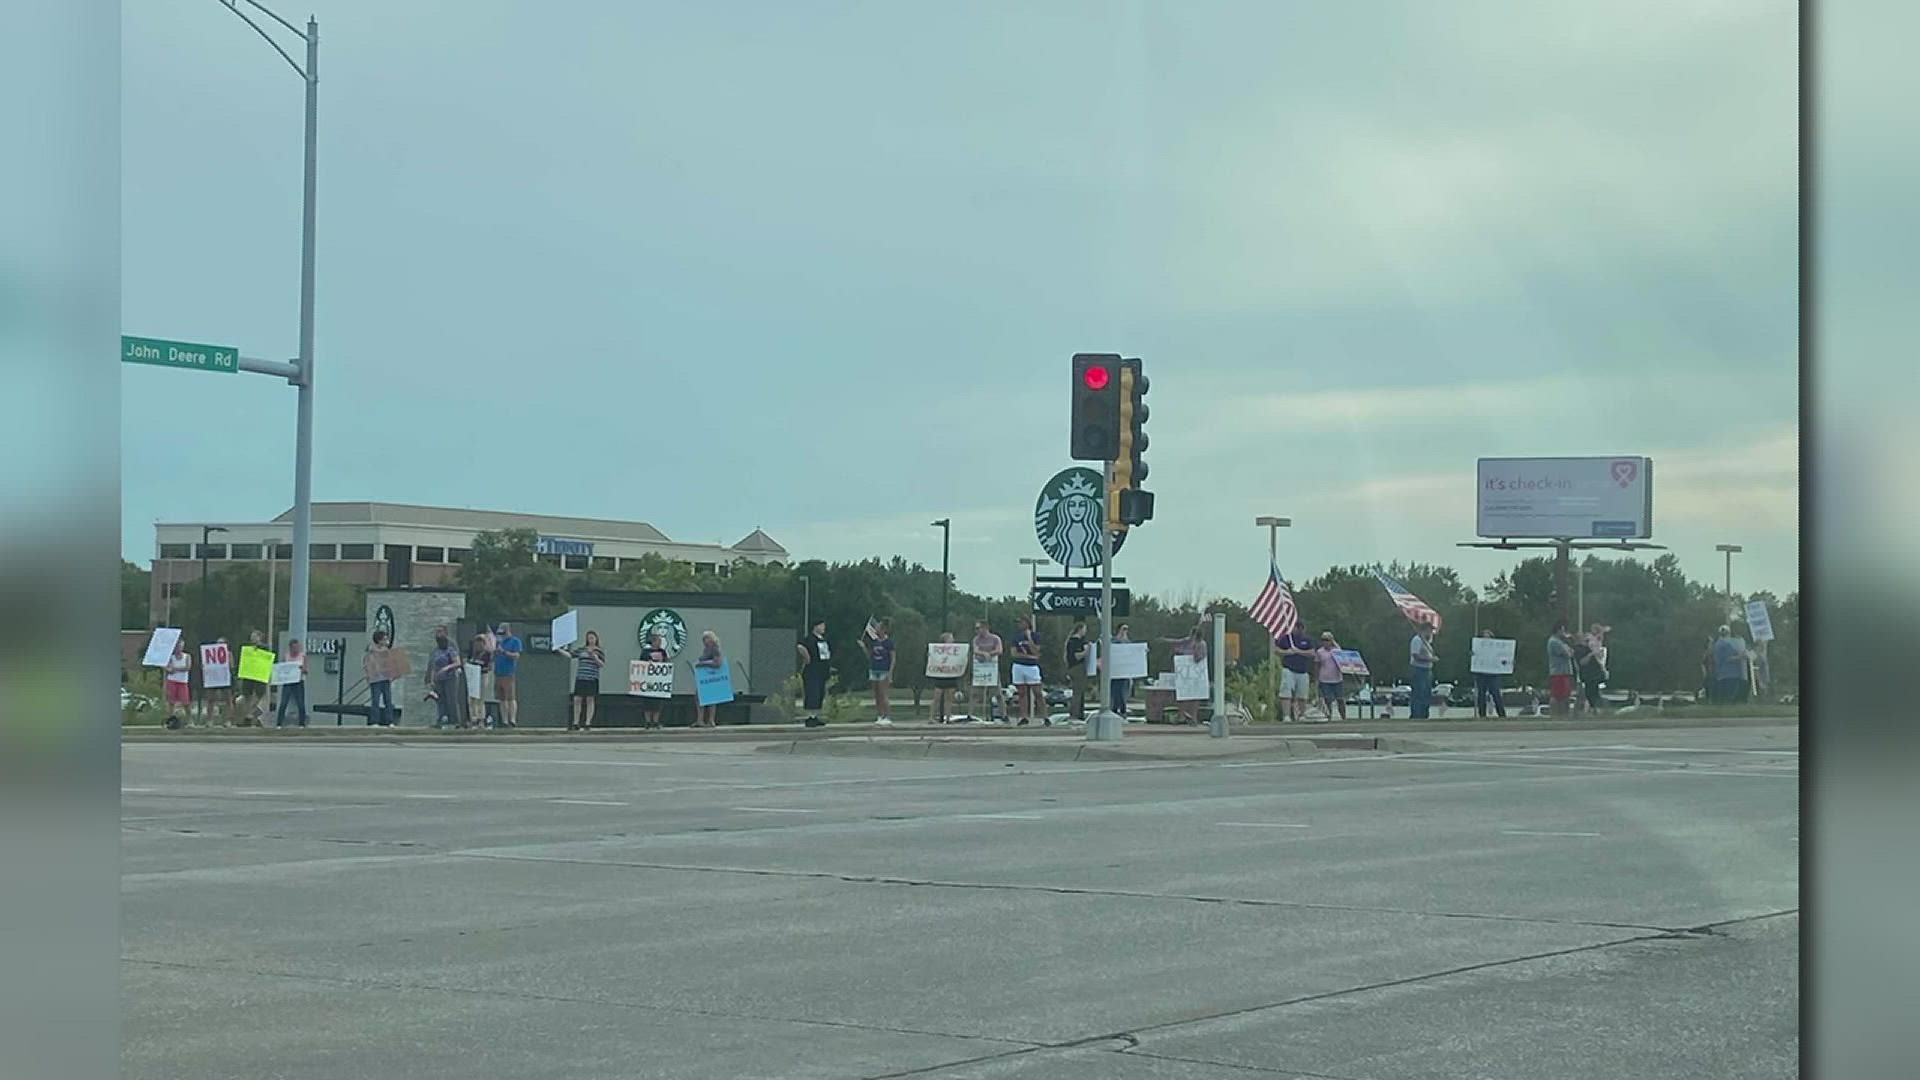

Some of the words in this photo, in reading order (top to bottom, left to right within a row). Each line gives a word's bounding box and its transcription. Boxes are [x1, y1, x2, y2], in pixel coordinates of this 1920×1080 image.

[126, 343, 160, 359] John
[168, 347, 206, 364] Deere
[214, 352, 232, 367] Rd
[1485, 477, 1505, 490] it's
[1509, 474, 1572, 490] check-in
[1055, 596, 1086, 607] DRIVE
[1087, 596, 1117, 608] THU
[205, 646, 227, 664] NO
[640, 681, 672, 692] CHOICE
